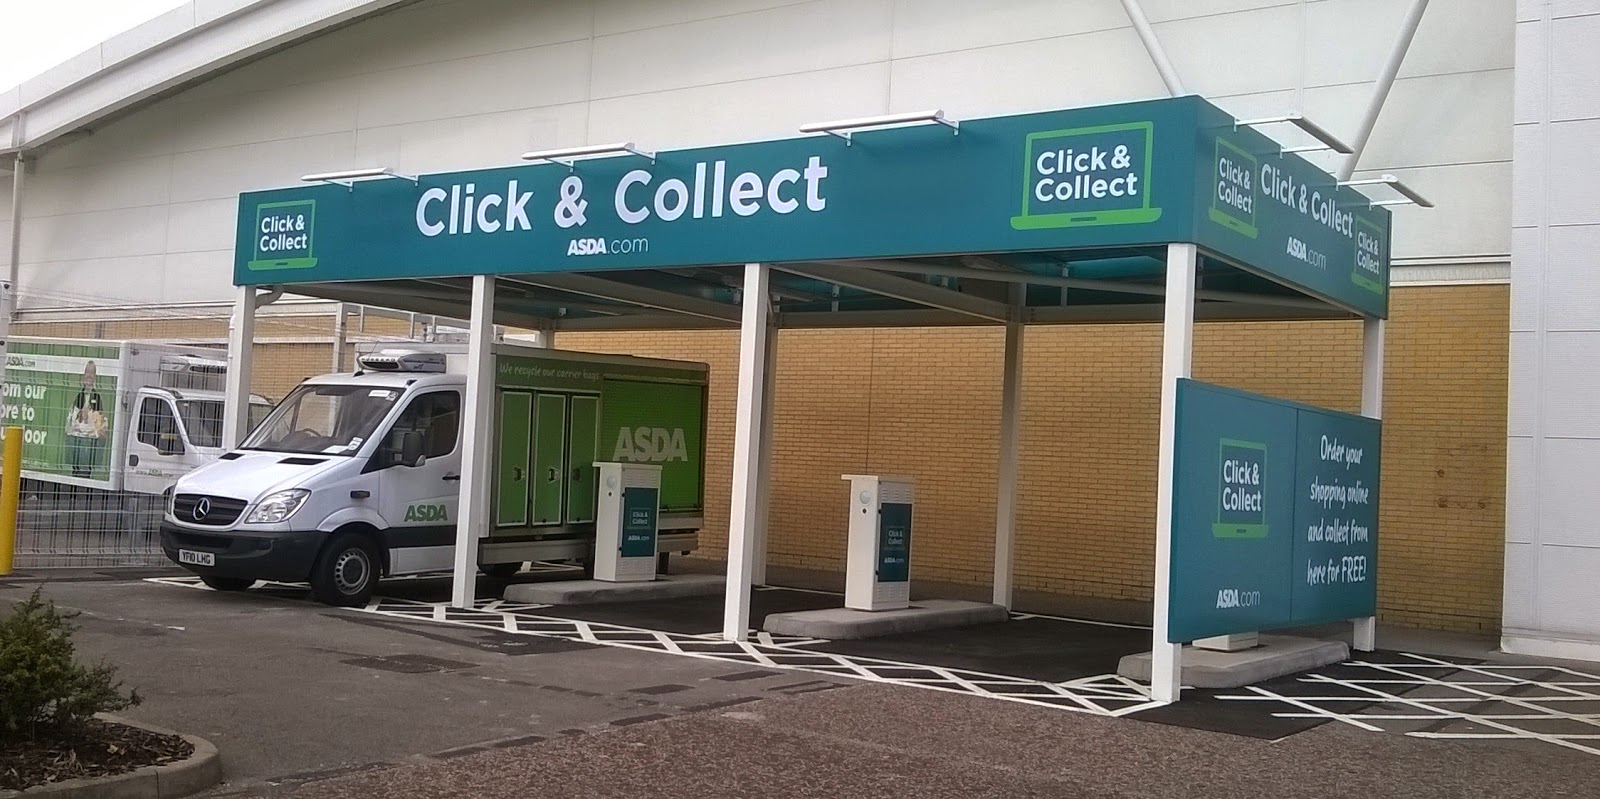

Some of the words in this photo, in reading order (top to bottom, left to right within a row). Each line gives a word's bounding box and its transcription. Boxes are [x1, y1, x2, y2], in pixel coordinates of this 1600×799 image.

[1036, 147, 1107, 176] Click
[1219, 157, 1243, 188] Click
[416, 180, 534, 237] Click
[554, 176, 588, 229] &
[615, 156, 828, 224] Collect
[1035, 172, 1138, 202] Collect
[1218, 180, 1252, 214] Collect
[1261, 163, 1296, 209] Click
[1299, 183, 1308, 215] &
[1311, 191, 1354, 238] Collect
[260, 214, 295, 234] Click
[259, 232, 308, 252] Collect
[567, 237, 649, 256] ASDA.com
[1286, 236, 1327, 271] ASDA.com
[1356, 249, 1380, 275] Collect
[499, 362, 513, 375] We
[514, 364, 541, 378] recycle
[542, 368, 555, 378] our
[2, 382, 21, 398] om
[24, 384, 47, 400] our
[0, 404, 19, 420] ore
[22, 403, 35, 421] to
[22, 424, 48, 445] oor
[612, 426, 689, 463] ASDA
[1320, 434, 1345, 463] Order
[1345, 447, 1363, 471] your
[1223, 459, 1251, 485] Click
[1222, 487, 1262, 512] Collect
[1310, 475, 1346, 510] shopping
[1347, 479, 1369, 505] online
[404, 503, 448, 523] ASDA
[1307, 517, 1324, 542] and
[1324, 517, 1349, 546] collect
[1350, 518, 1368, 544] from
[1307, 558, 1327, 587] here
[1327, 558, 1340, 585] for
[1341, 555, 1367, 583] FREE!
[1216, 588, 1261, 609] ASDA.com
